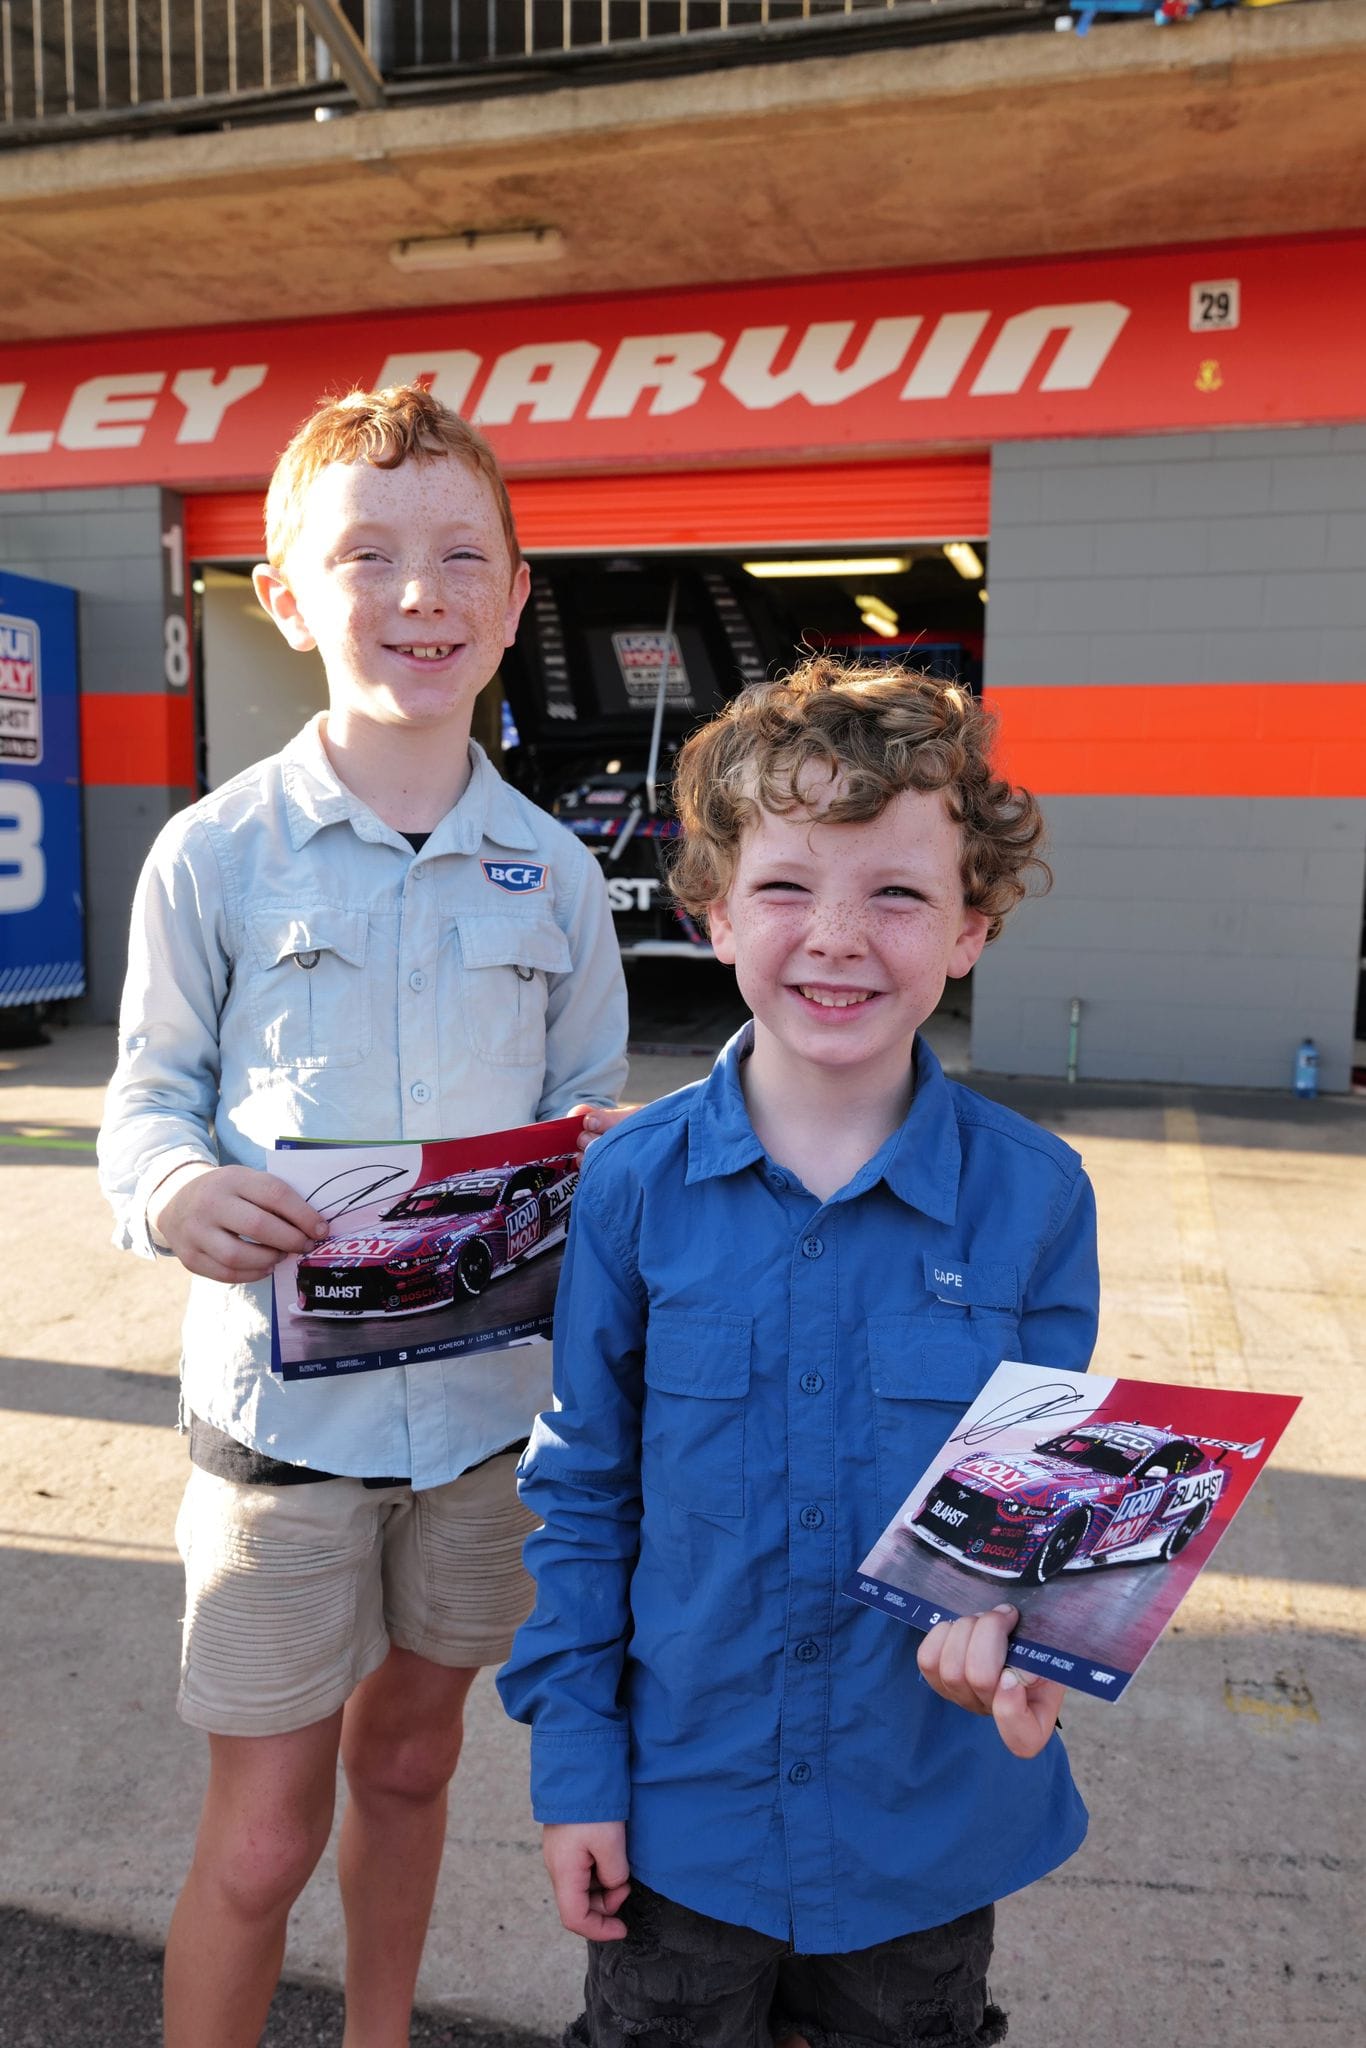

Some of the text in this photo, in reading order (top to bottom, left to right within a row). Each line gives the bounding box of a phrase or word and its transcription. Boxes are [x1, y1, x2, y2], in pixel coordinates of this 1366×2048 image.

[1200, 292, 1229, 320] 29
[490, 866, 537, 885] BCF
[508, 1201, 539, 1236] LIQUI
[316, 1240, 399, 1255] MOLY
[510, 1222, 540, 1256] MOLY
[314, 1285, 363, 1299] BLAHST
[933, 1268, 963, 1288] CAPE
[400, 1287, 437, 1303] BOSCH
[416, 1346, 436, 1356] AARON
[438, 1340, 465, 1351] CAMERON
[476, 1334, 494, 1343] LIQUI
[497, 1327, 512, 1336] MOLY
[515, 1321, 535, 1332] BLAHST
[964, 1460, 1029, 1487] MOLY
[1114, 1486, 1163, 1523] LIQUI
[1170, 1474, 1222, 1510] BLAHST
[930, 1499, 969, 1528] BLAHST
[1096, 1514, 1149, 1549] MOLY
[982, 1543, 1018, 1559] BOSCH
[929, 1612, 941, 1625] 3
[1013, 1644, 1075, 1672] MOLY BLAHST RACING
